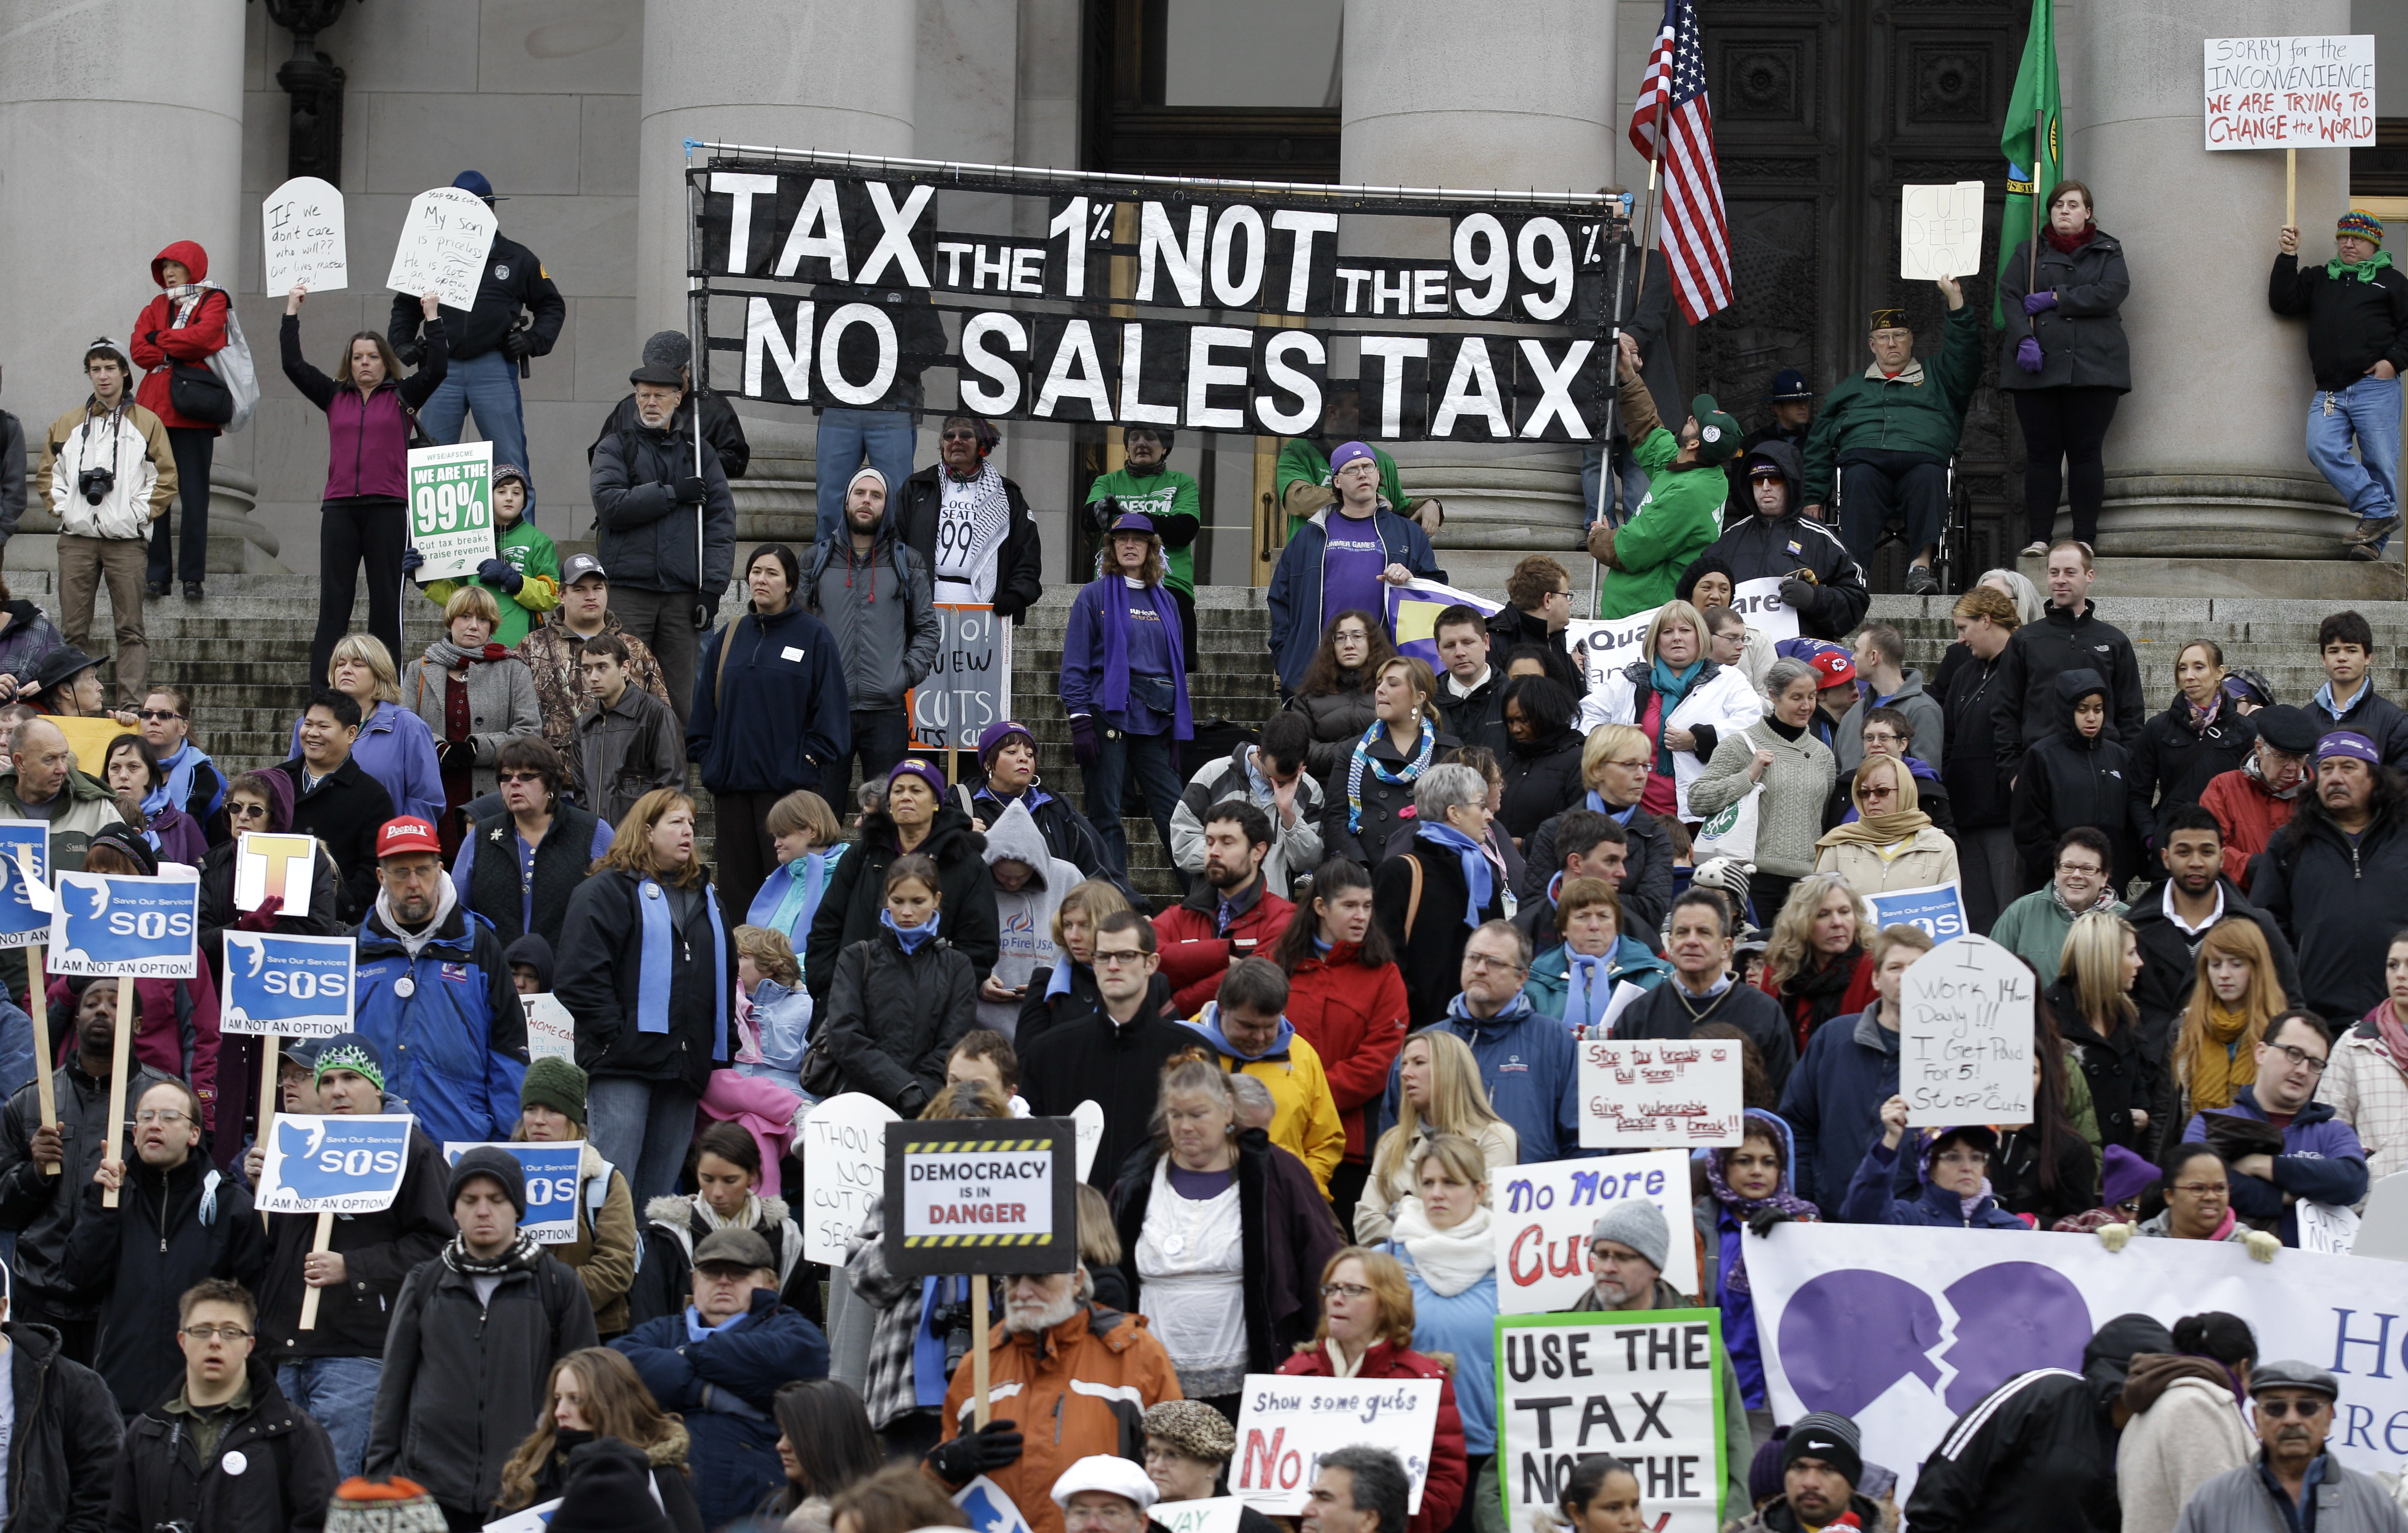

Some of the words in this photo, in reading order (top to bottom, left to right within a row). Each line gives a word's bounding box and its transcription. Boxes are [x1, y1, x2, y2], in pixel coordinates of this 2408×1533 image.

[2217, 40, 2281, 66] SORRY
[2288, 38, 2312, 65] for
[2316, 38, 2347, 61] the
[2206, 93, 2232, 114] WE
[2237, 92, 2274, 114] ARE
[2283, 90, 2342, 117] TRYING
[2349, 92, 2369, 112] TO
[2209, 115, 2287, 145] CHANGE
[2293, 119, 2314, 136] the
[2318, 116, 2373, 143] WORLD
[270, 201, 295, 229] If
[303, 204, 321, 218] we
[1907, 187, 1982, 218] CUT
[424, 206, 446, 230] My
[272, 226, 300, 242] don't
[307, 226, 335, 237] care
[1908, 218, 1976, 245] DEEP
[276, 245, 295, 258] who
[302, 240, 334, 255] will??
[437, 236, 483, 258] priceless
[711, 173, 934, 287] TAX
[938, 243, 1046, 293] THE
[1051, 197, 1113, 296] 1%
[1136, 202, 1337, 312] NOT
[1336, 269, 1447, 314] THE
[1454, 213, 1599, 320] 99%
[271, 266, 287, 277] Our
[294, 261, 312, 272] lives
[317, 258, 345, 269] matter
[404, 251, 419, 267] He
[428, 259, 436, 270] is
[443, 266, 468, 277] not
[1907, 243, 1981, 276] NOW
[393, 276, 406, 286] I
[408, 278, 425, 292] love
[411, 271, 425, 280] an
[435, 276, 476, 294] option!
[745, 297, 898, 404] NO
[961, 312, 1325, 434] SALES
[1361, 337, 1594, 438] TAX
[427, 450, 474, 461] WFSE/AFSCME
[414, 469, 434, 485] WE
[436, 465, 461, 482] ARE
[462, 463, 486, 478] THE
[416, 480, 485, 533] 99%
[419, 540, 435, 551] Cut
[439, 539, 452, 548] tax
[457, 534, 488, 545] breaks
[430, 550, 452, 559] raise
[454, 545, 490, 556] revenue
[940, 520, 972, 568] 99
[915, 690, 993, 727] CUTS
[247, 836, 310, 911] T
[1922, 901, 1956, 912] Services
[108, 912, 192, 940] SOS
[1011, 937, 1031, 948] Fire
[54, 957, 58, 969] I
[62, 960, 82, 971] AM
[87, 961, 114, 972] NOT
[117, 962, 136, 973] AN
[140, 962, 192, 974] OPTION!
[1956, 941, 1986, 971] I
[263, 970, 346, 999] SOS
[1999, 977, 2017, 1002] 14
[223, 1016, 227, 1028] I
[228, 1019, 241, 1029] AM
[246, 1020, 268, 1031] NOT
[272, 1022, 289, 1032] AN
[293, 1022, 348, 1034] OPTION!
[529, 1018, 557, 1036] HOME
[1911, 1004, 1968, 1038] Daily
[1587, 1044, 1621, 1063] Stop
[1659, 1045, 1701, 1062] breaks
[1711, 1048, 1726, 1059] on
[1910, 1036, 1935, 1060] I
[1943, 1038, 1987, 1061] Get
[1989, 1037, 2023, 1061] Paid
[1615, 1068, 1635, 1081] Bull
[1924, 1064, 1954, 1081] For
[1590, 1095, 1624, 1114] Give
[1637, 1100, 1708, 1115] vulnerable
[1984, 1092, 2027, 1112] Cuts
[1617, 1116, 1657, 1132] people
[1665, 1117, 1676, 1128] a
[810, 1121, 868, 1154] THOU
[318, 1149, 399, 1176] SOS
[911, 1161, 1046, 1181] DEMOCRACY
[525, 1177, 575, 1206] OS
[814, 1188, 853, 1212] CUT
[960, 1187, 972, 1197] IS
[977, 1187, 991, 1197] IN
[1570, 1169, 1664, 1206] More
[262, 1194, 267, 1206] I
[271, 1198, 291, 1209] AM
[295, 1199, 318, 1209] NOT
[321, 1199, 338, 1209] AN
[342, 1196, 391, 1209] OPTION!
[929, 1203, 1025, 1224] DANGER
[530, 1226, 574, 1240] OPTION!
[1507, 1332, 1594, 1382] USE
[1614, 1325, 1711, 1371] THE
[2326, 1307, 2408, 1379] H
[1311, 1395, 1358, 1410] some
[1359, 1387, 1417, 1423] guts
[1514, 1390, 1673, 1449] TAX
[1239, 1427, 1301, 1490] No
[1522, 1451, 1609, 1503] NO
